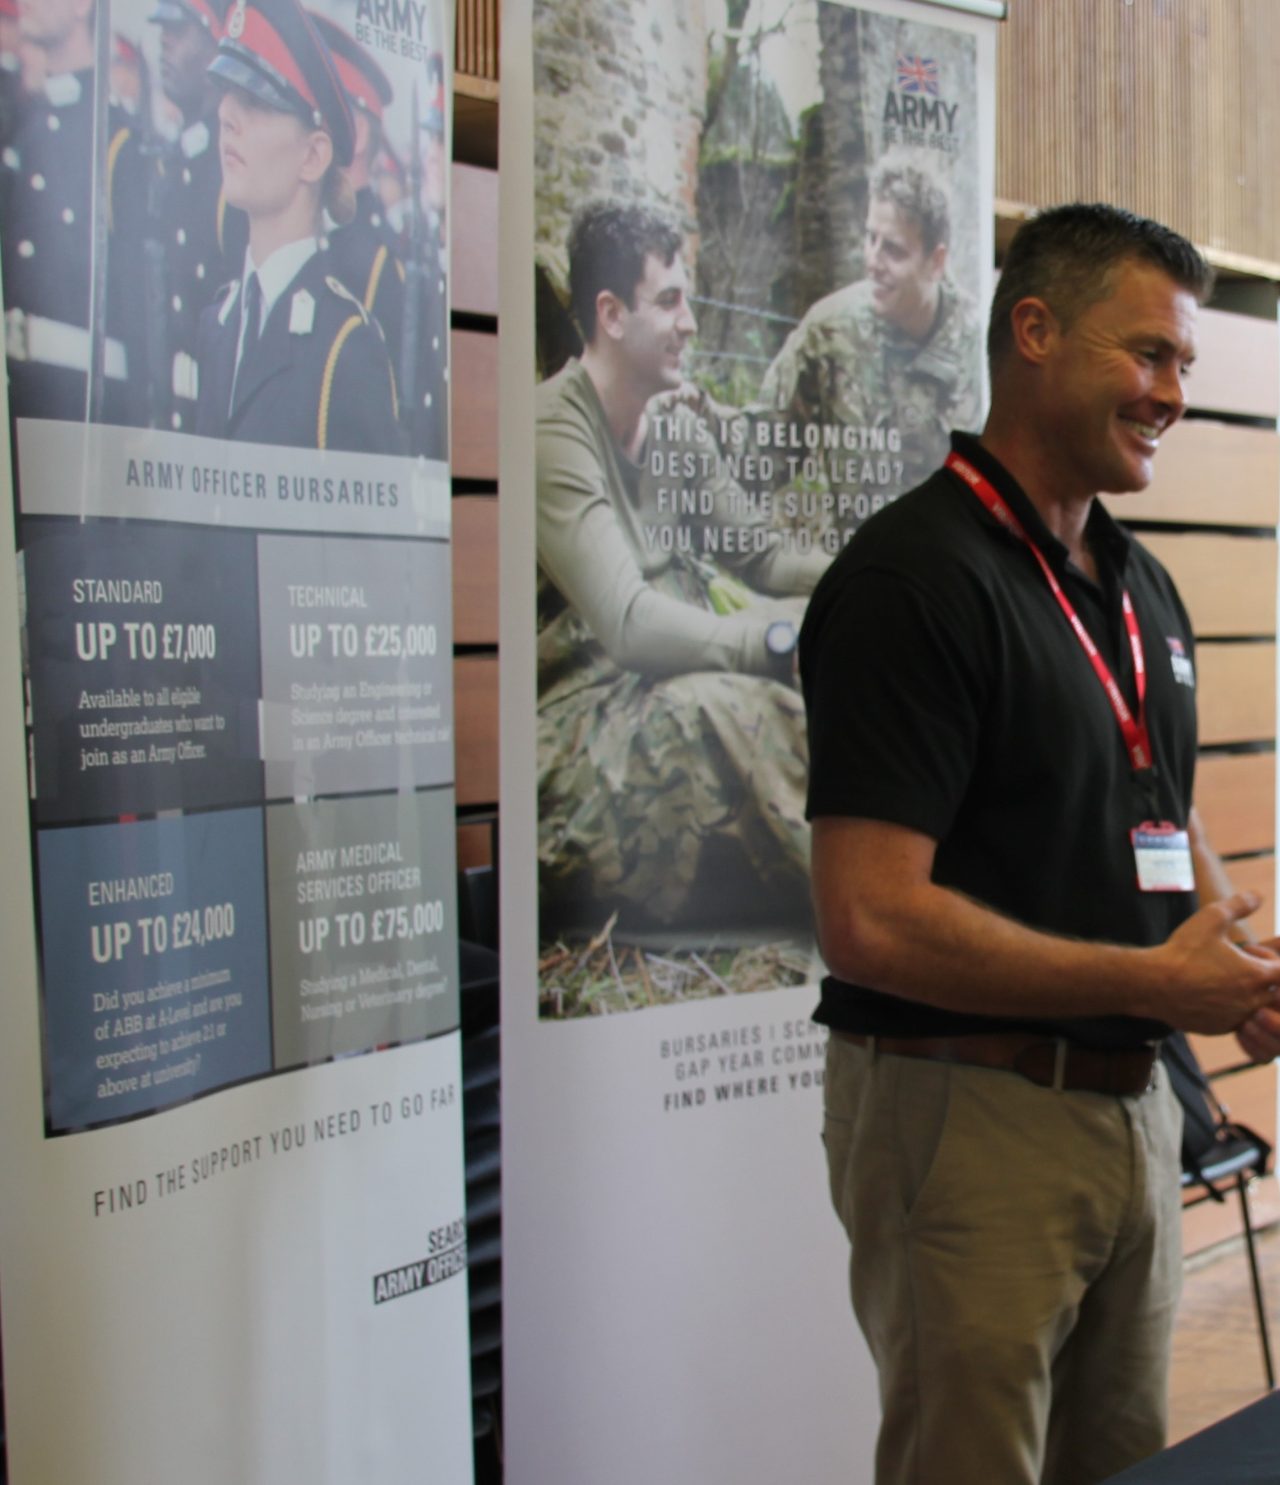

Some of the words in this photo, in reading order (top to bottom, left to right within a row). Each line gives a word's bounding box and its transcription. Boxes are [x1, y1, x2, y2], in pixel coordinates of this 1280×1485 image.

[356, 0, 427, 41] ARMY
[356, 22, 372, 45] BE
[374, 28, 397, 54] THE
[401, 38, 427, 62] BEST
[883, 90, 958, 133] ARMY
[653, 415, 708, 443] THIS
[721, 420, 745, 445] IS
[756, 421, 901, 452] BELONGING
[126, 459, 184, 490] ARMY
[192, 466, 267, 499] OFFICER
[277, 475, 399, 507] BURSARIES
[651, 452, 774, 482] DESTINED
[786, 457, 819, 482] TO
[830, 459, 904, 485] LEAD?
[657, 488, 714, 516] FIND
[726, 491, 772, 517] THE
[784, 494, 898, 520] SUPPOR
[645, 524, 692, 552] YOU
[704, 527, 769, 553] NEED
[780, 528, 812, 553] TO
[73, 579, 163, 604] STANDARD
[287, 585, 368, 608] TECHNICAL
[75, 622, 117, 661] UP
[123, 623, 156, 660] TO
[163, 624, 216, 663] £7,000
[289, 623, 322, 658] UP
[327, 624, 358, 657] TO
[365, 625, 437, 660] £25,000
[79, 688, 141, 709] Available
[143, 690, 154, 706] to
[156, 686, 169, 706] all
[342, 685, 357, 699] an
[80, 716, 173, 739] undergraduates
[175, 714, 192, 732] who
[194, 716, 214, 731] want
[215, 715, 225, 730] to
[335, 707, 373, 726] degree
[375, 705, 395, 722] and
[81, 748, 109, 771] join
[112, 750, 128, 764] as
[131, 749, 146, 763] an
[149, 744, 176, 764] Army
[323, 733, 353, 750] Army
[296, 848, 337, 874] ARMY
[340, 841, 404, 868] MEDICAL
[88, 872, 174, 906] ENHANCED
[297, 873, 364, 904] SERVICES
[367, 867, 421, 894] OFFICER
[91, 921, 131, 963] UP
[138, 915, 168, 955] TO
[172, 902, 235, 949] £24,000
[299, 917, 329, 954] UP
[335, 911, 366, 947] TO
[371, 900, 444, 942] £75,000
[93, 989, 119, 1012] Did
[122, 990, 145, 1011] you
[147, 979, 184, 1002] achieve
[95, 1019, 110, 1041] of
[113, 1014, 143, 1038] ABB
[145, 1016, 156, 1030] at
[159, 1002, 192, 1028] A-Level
[193, 997, 208, 1018] and
[209, 996, 222, 1014] are
[224, 992, 243, 1013] you
[96, 1041, 157, 1070] expecting
[159, 1039, 171, 1056] to
[659, 1025, 762, 1060] BURSARIES
[675, 1058, 710, 1081] GAP
[718, 1050, 764, 1073] YEAR
[97, 1076, 138, 1098] above
[140, 1071, 152, 1084] at
[663, 1088, 706, 1112] FIND
[714, 1075, 779, 1103] WHERE
[94, 1179, 148, 1217] FIND
[156, 1165, 185, 1198] THE
[192, 1136, 262, 1184] SUPPORT
[270, 1123, 305, 1155] YOU
[314, 1109, 361, 1142] NEED
[370, 1101, 392, 1126] TO
[401, 1093, 423, 1119] GO
[430, 1083, 454, 1111] FAR
[376, 1262, 425, 1302] ARMY
